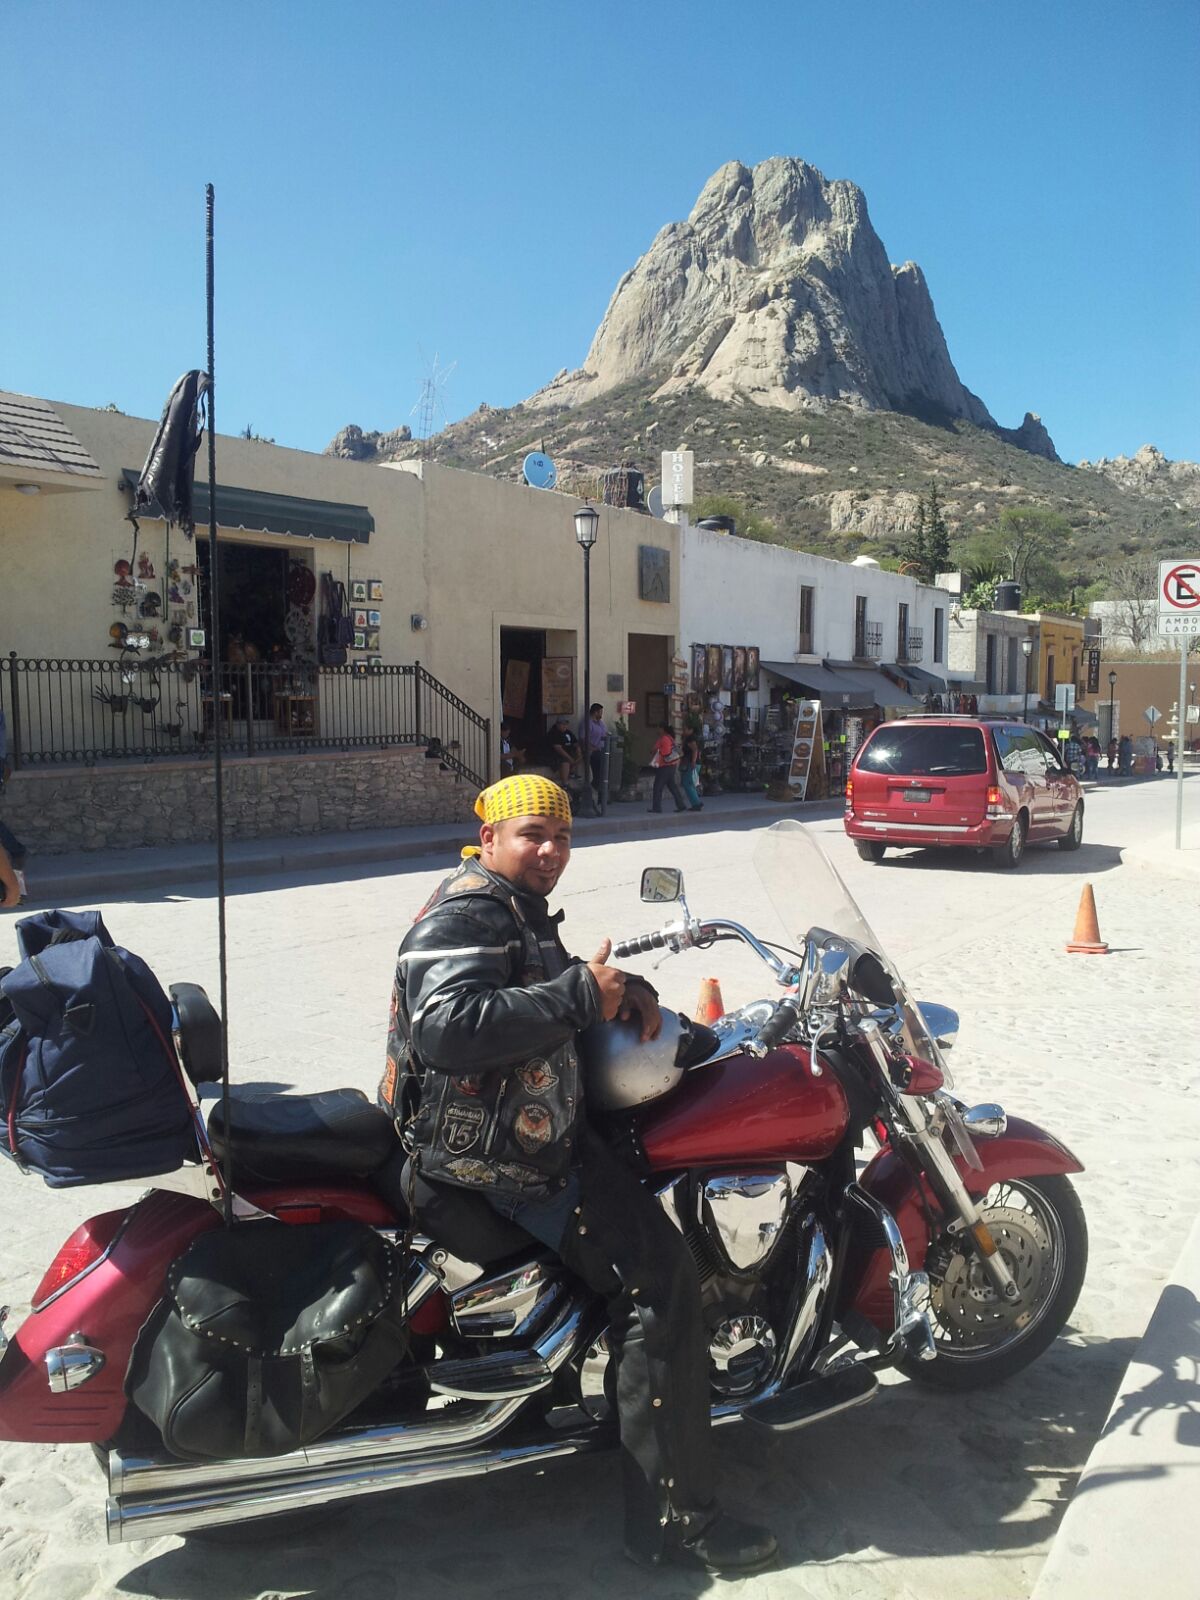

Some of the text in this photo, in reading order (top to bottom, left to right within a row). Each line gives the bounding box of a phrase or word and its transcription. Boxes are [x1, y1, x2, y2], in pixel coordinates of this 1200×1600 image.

[671, 453, 684, 505] HOTEL
[1090, 651, 1098, 686] HOTEL
[448, 1122, 472, 1146] 15
